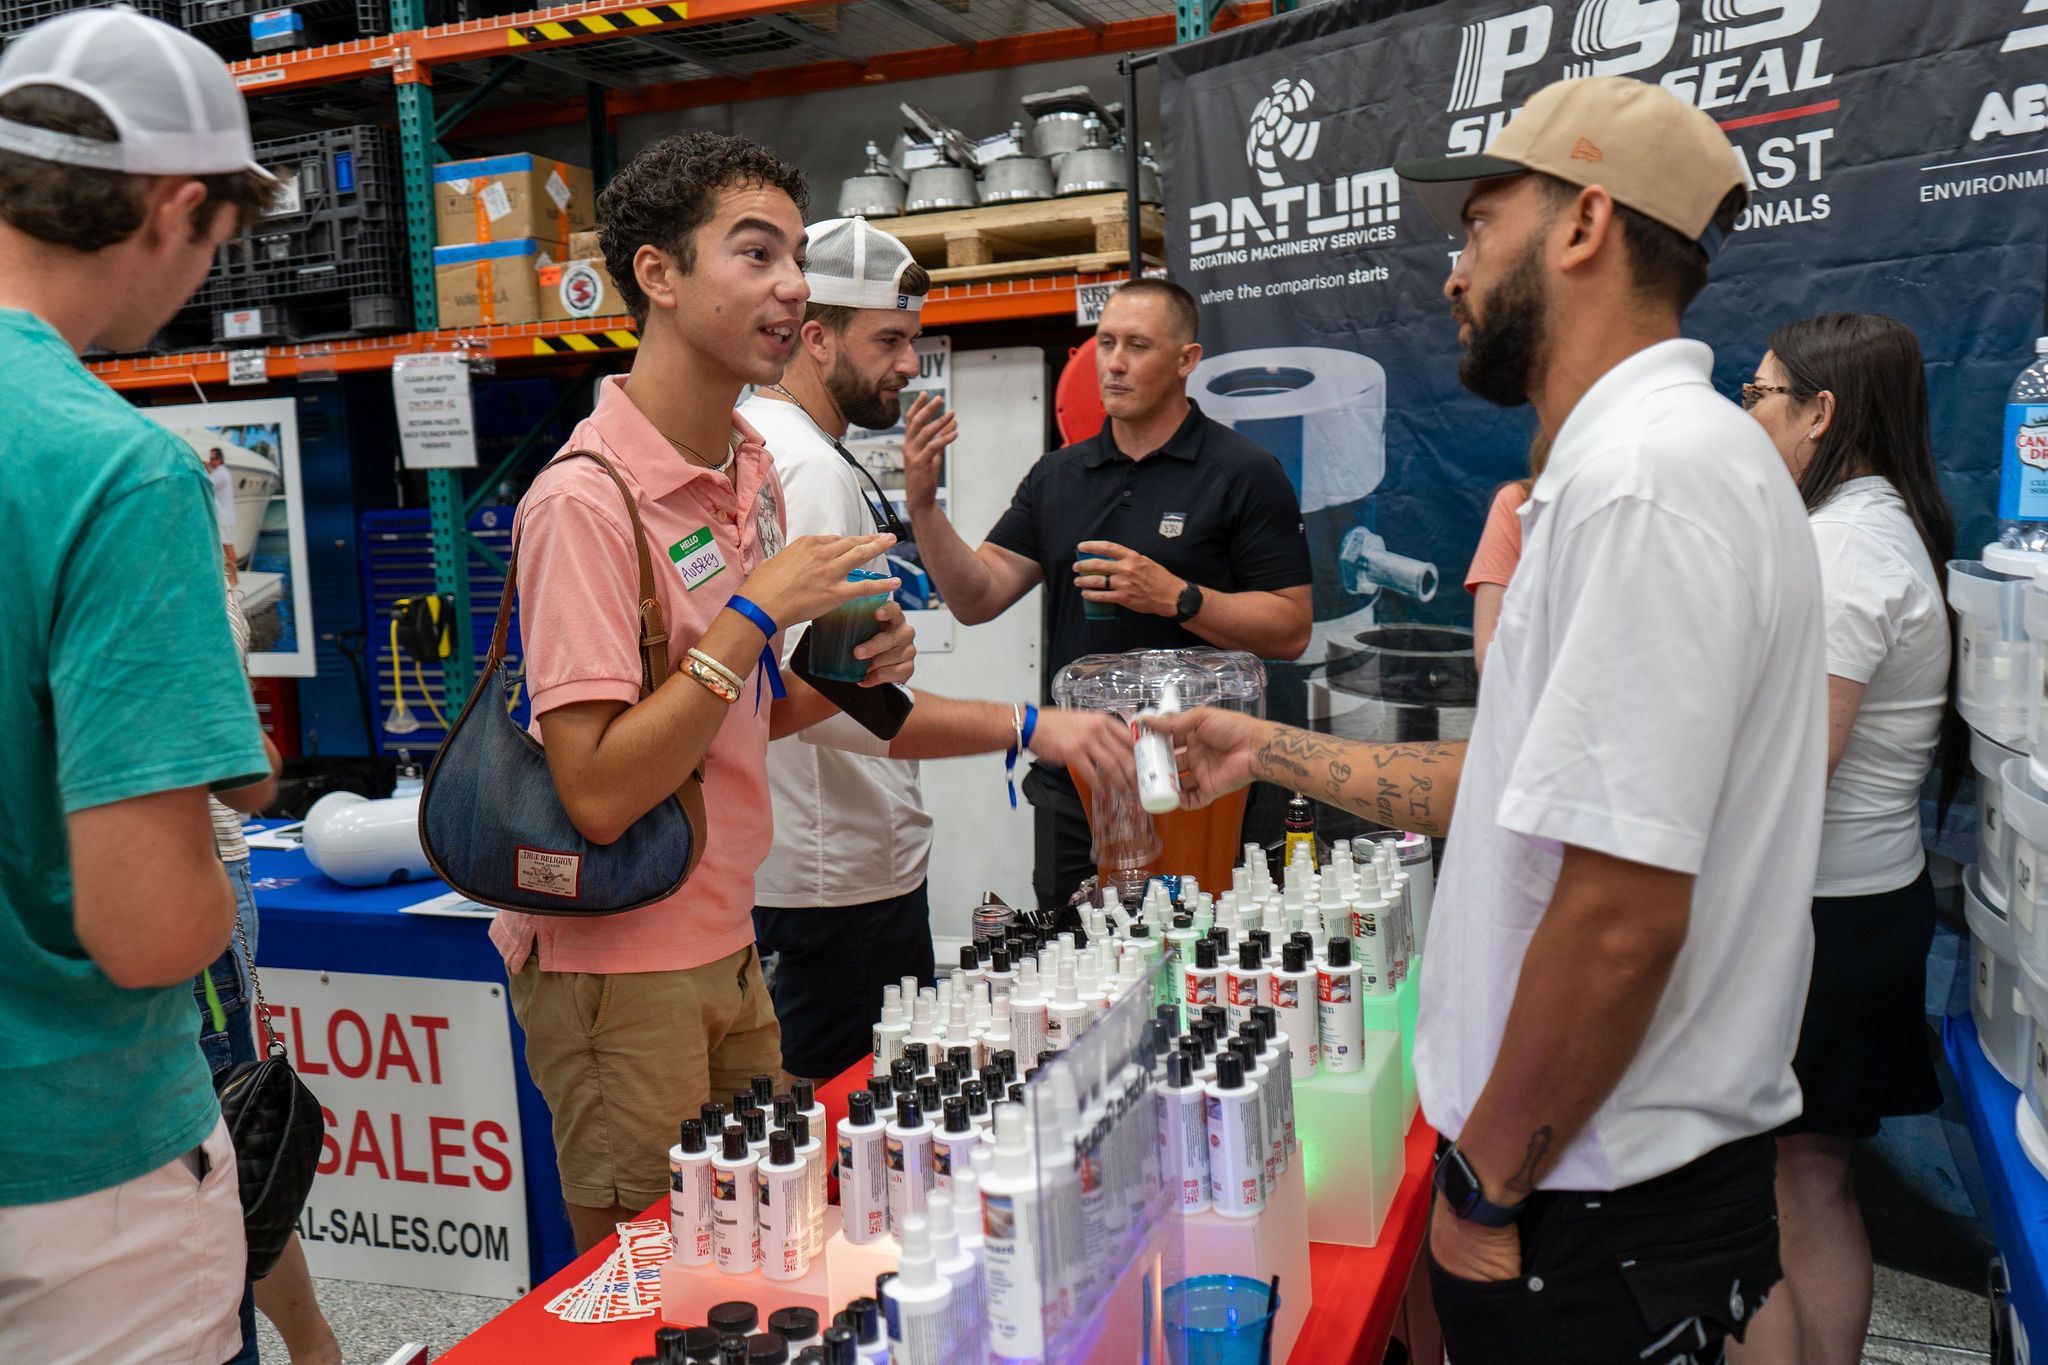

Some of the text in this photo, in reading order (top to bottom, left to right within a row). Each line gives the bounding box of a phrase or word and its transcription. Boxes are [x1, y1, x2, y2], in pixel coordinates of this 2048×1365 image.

[1658, 38, 1834, 110] SEAL
[1731, 127, 1835, 192] AST
[1189, 166, 1401, 255] DATUM
[1733, 193, 1832, 232] ONALS
[1189, 224, 1397, 272] ROTATING MACHINERY SERVICES
[1200, 265, 1389, 305] where the comparison starts
[919, 352, 946, 379] UY
[2016, 434, 2048, 448] CAN
[2030, 448, 2048, 460] DR
[679, 535, 699, 551] HELLO
[681, 553, 720, 583] AUBREY
[523, 851, 573, 867] TRUE RELIGION
[254, 1003, 450, 1085] FLOAT
[315, 1105, 513, 1192] SALES
